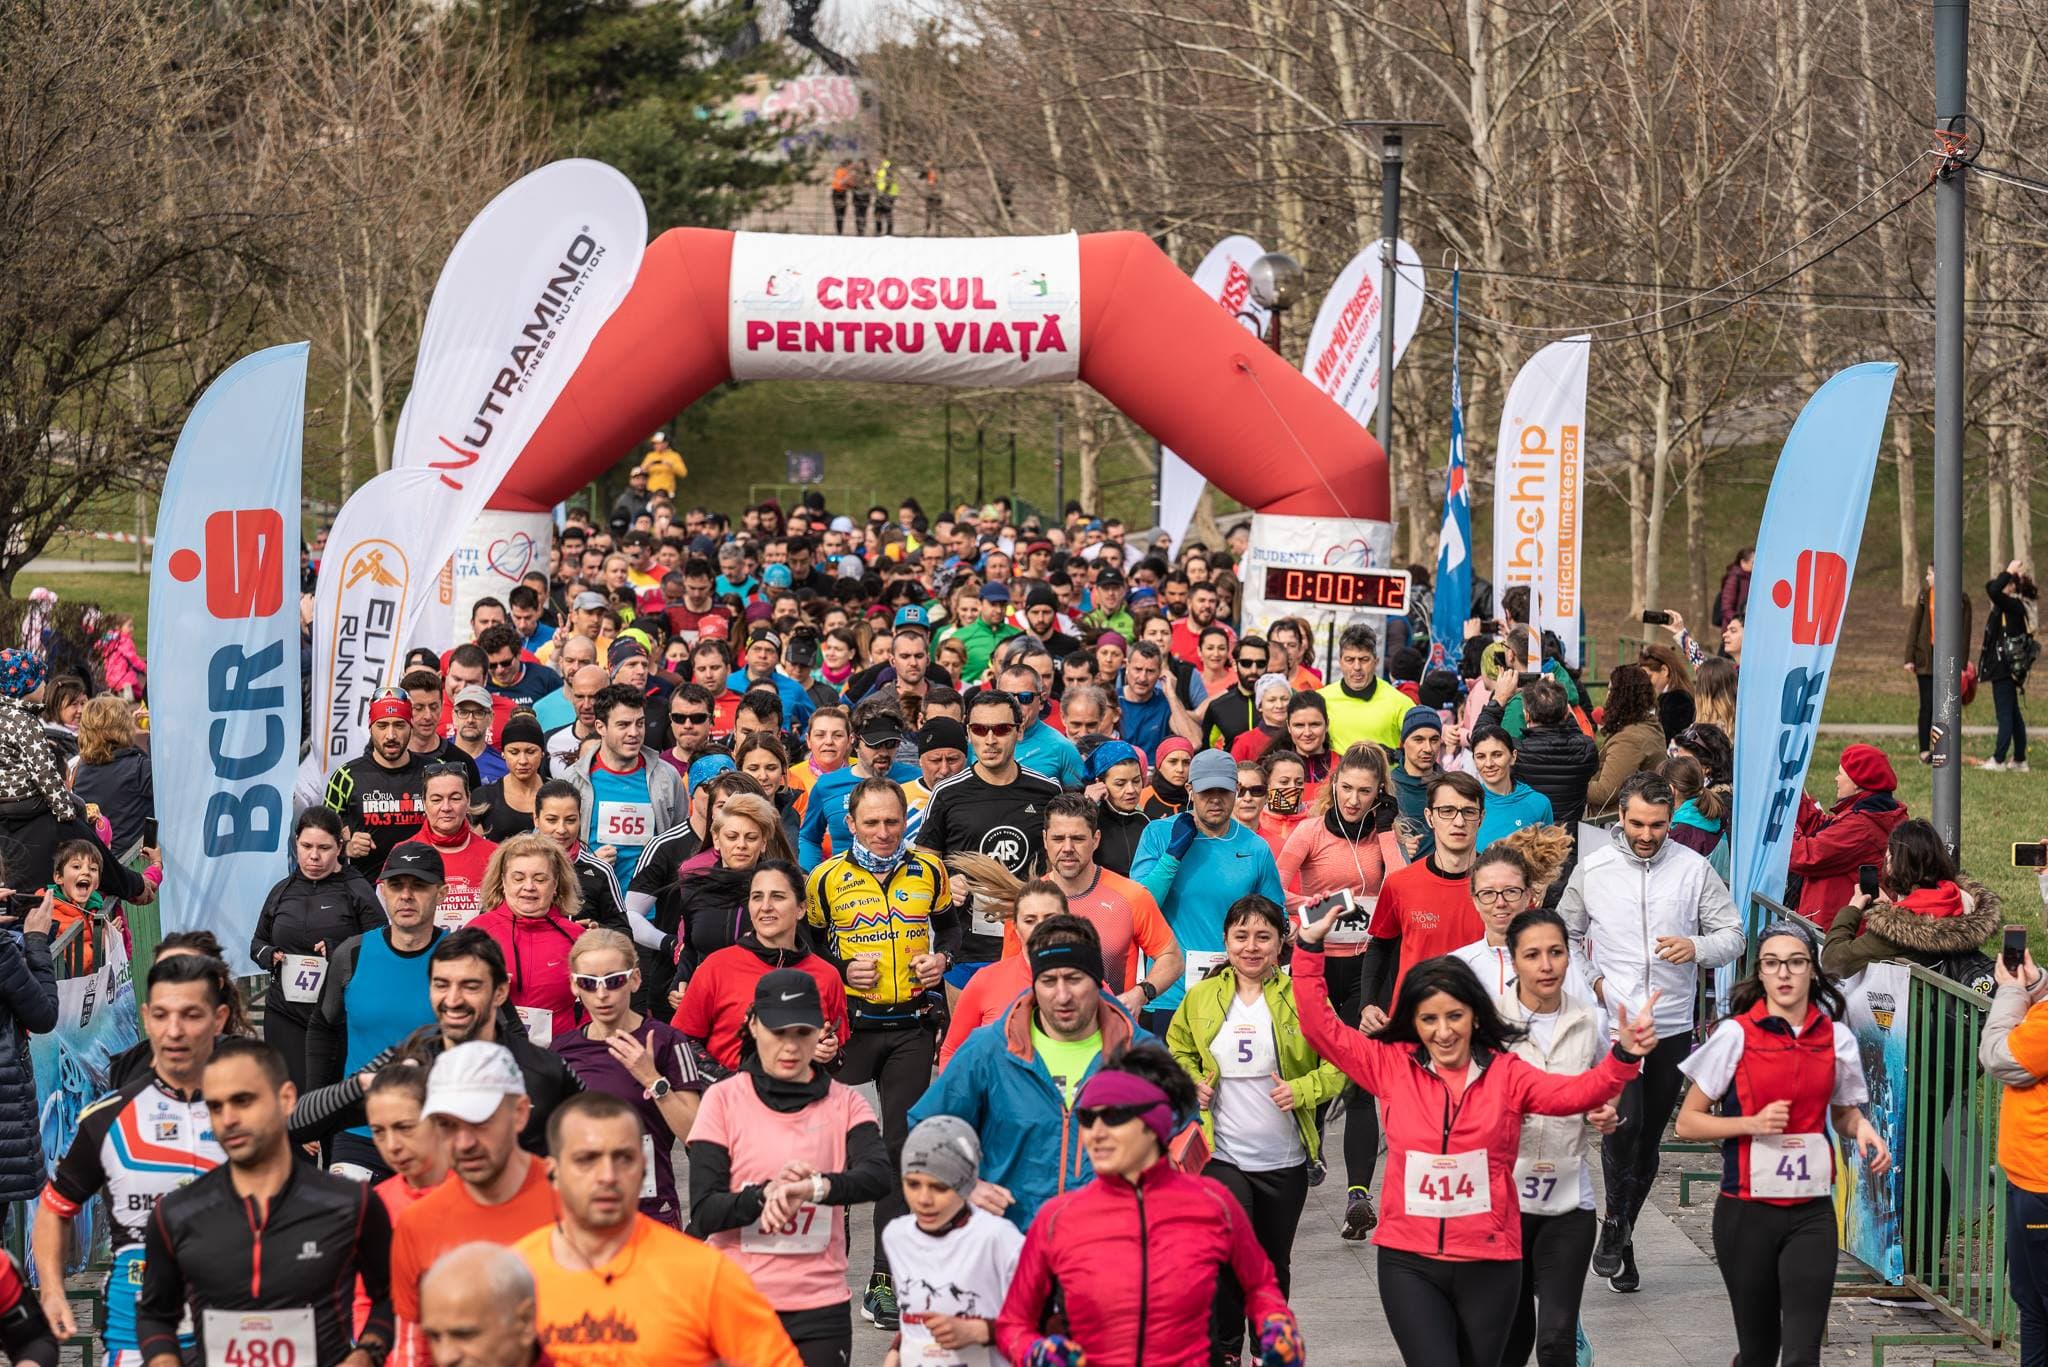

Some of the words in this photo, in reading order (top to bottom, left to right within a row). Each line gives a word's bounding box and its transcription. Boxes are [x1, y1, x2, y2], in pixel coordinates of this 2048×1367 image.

[816, 276, 997, 311] CROSUL
[517, 330, 556, 393] FITNESS
[555, 246, 606, 326] NUTRITION
[746, 320, 925, 353] PENTRU
[1342, 357, 1369, 408] UPLIMENTE
[1560, 431, 1578, 541] timekeeper
[1507, 424, 1555, 584] ibchip
[1557, 544, 1574, 614] official
[330, 615, 359, 756] RUNNING
[202, 637, 286, 858] BCR
[362, 798, 426, 813] IRONMA
[393, 813, 427, 825] Turk
[608, 815, 645, 835] 565
[436, 903, 459, 911] NTRU
[847, 930, 900, 943] schneider
[294, 970, 321, 991] 47
[1238, 1039, 1253, 1063] 5
[1776, 1154, 1811, 1181] 41
[1418, 1173, 1475, 1201] 414
[1521, 1176, 1558, 1201] 37
[758, 1206, 817, 1235] 87
[224, 1338, 296, 1367] 480
